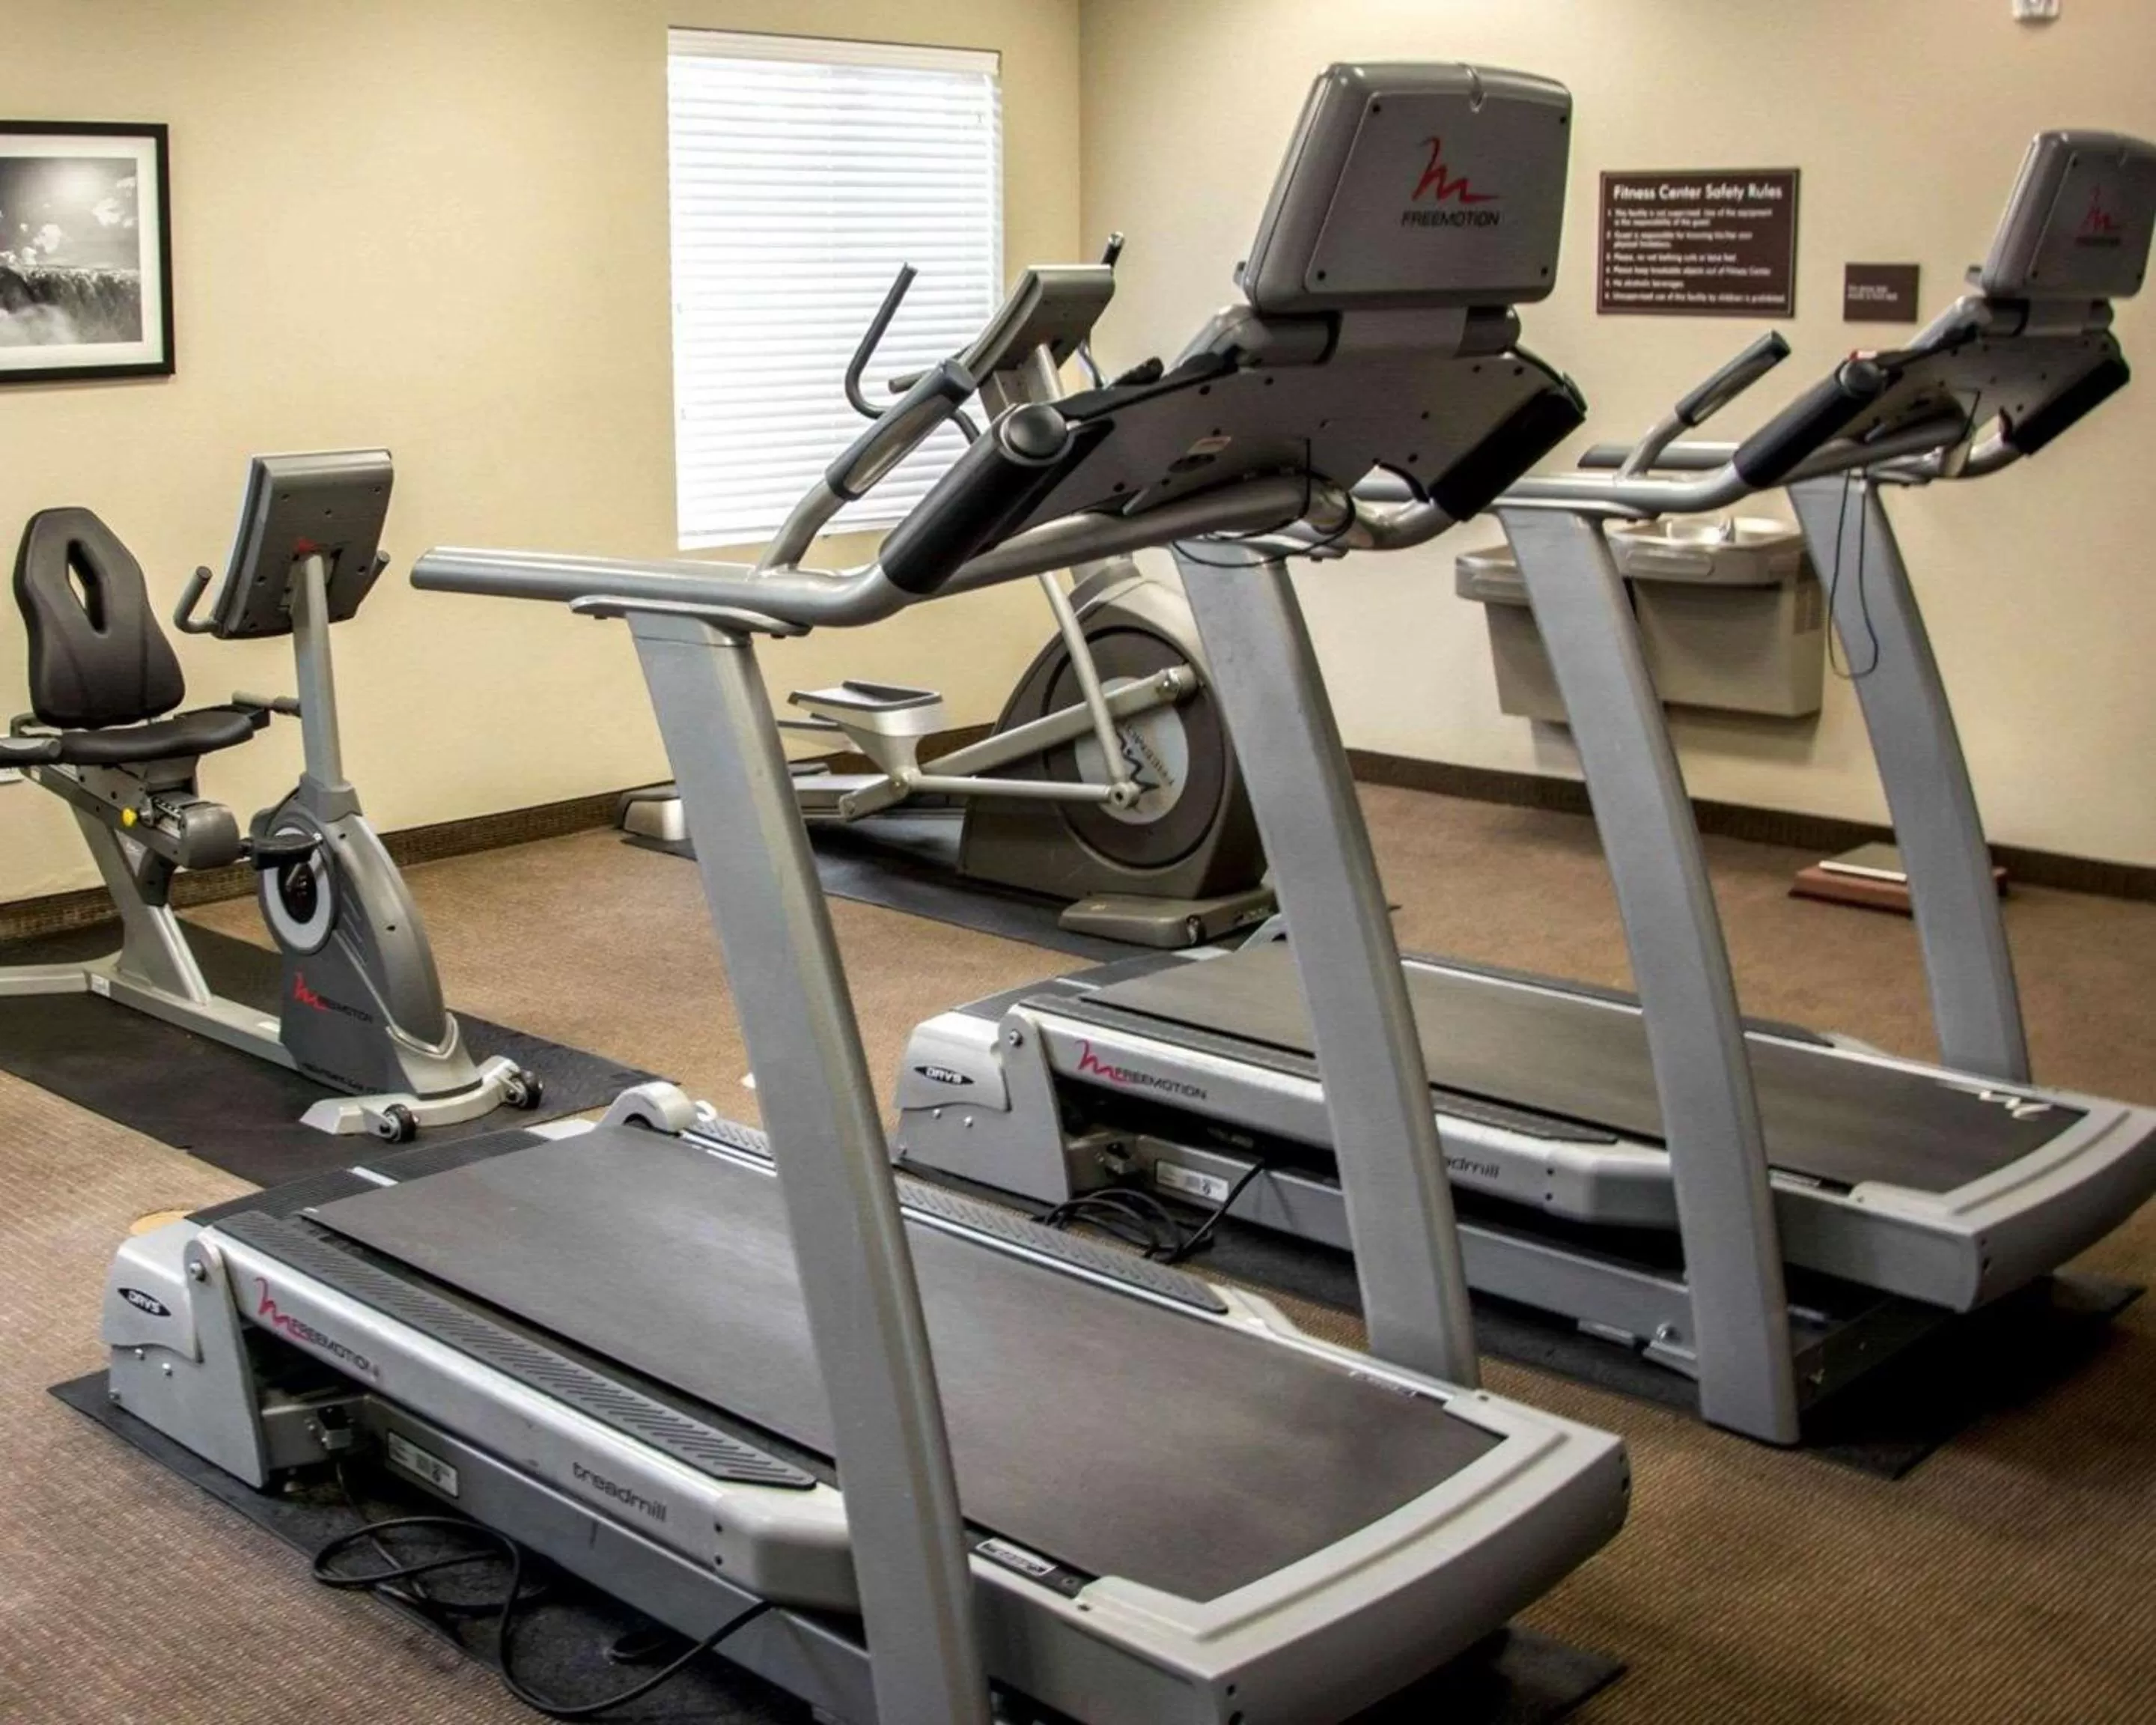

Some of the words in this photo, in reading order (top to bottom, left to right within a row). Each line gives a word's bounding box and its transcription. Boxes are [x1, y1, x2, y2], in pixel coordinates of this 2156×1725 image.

[1613, 184, 1655, 201] Fitness
[1659, 183, 1701, 201] Center
[1705, 183, 1744, 204] Safety
[1747, 183, 1782, 201] Rules
[1401, 210, 1501, 228] FREEMOTION
[1449, 1157, 1500, 1179] dmill
[573, 1461, 667, 1522] treadmill
